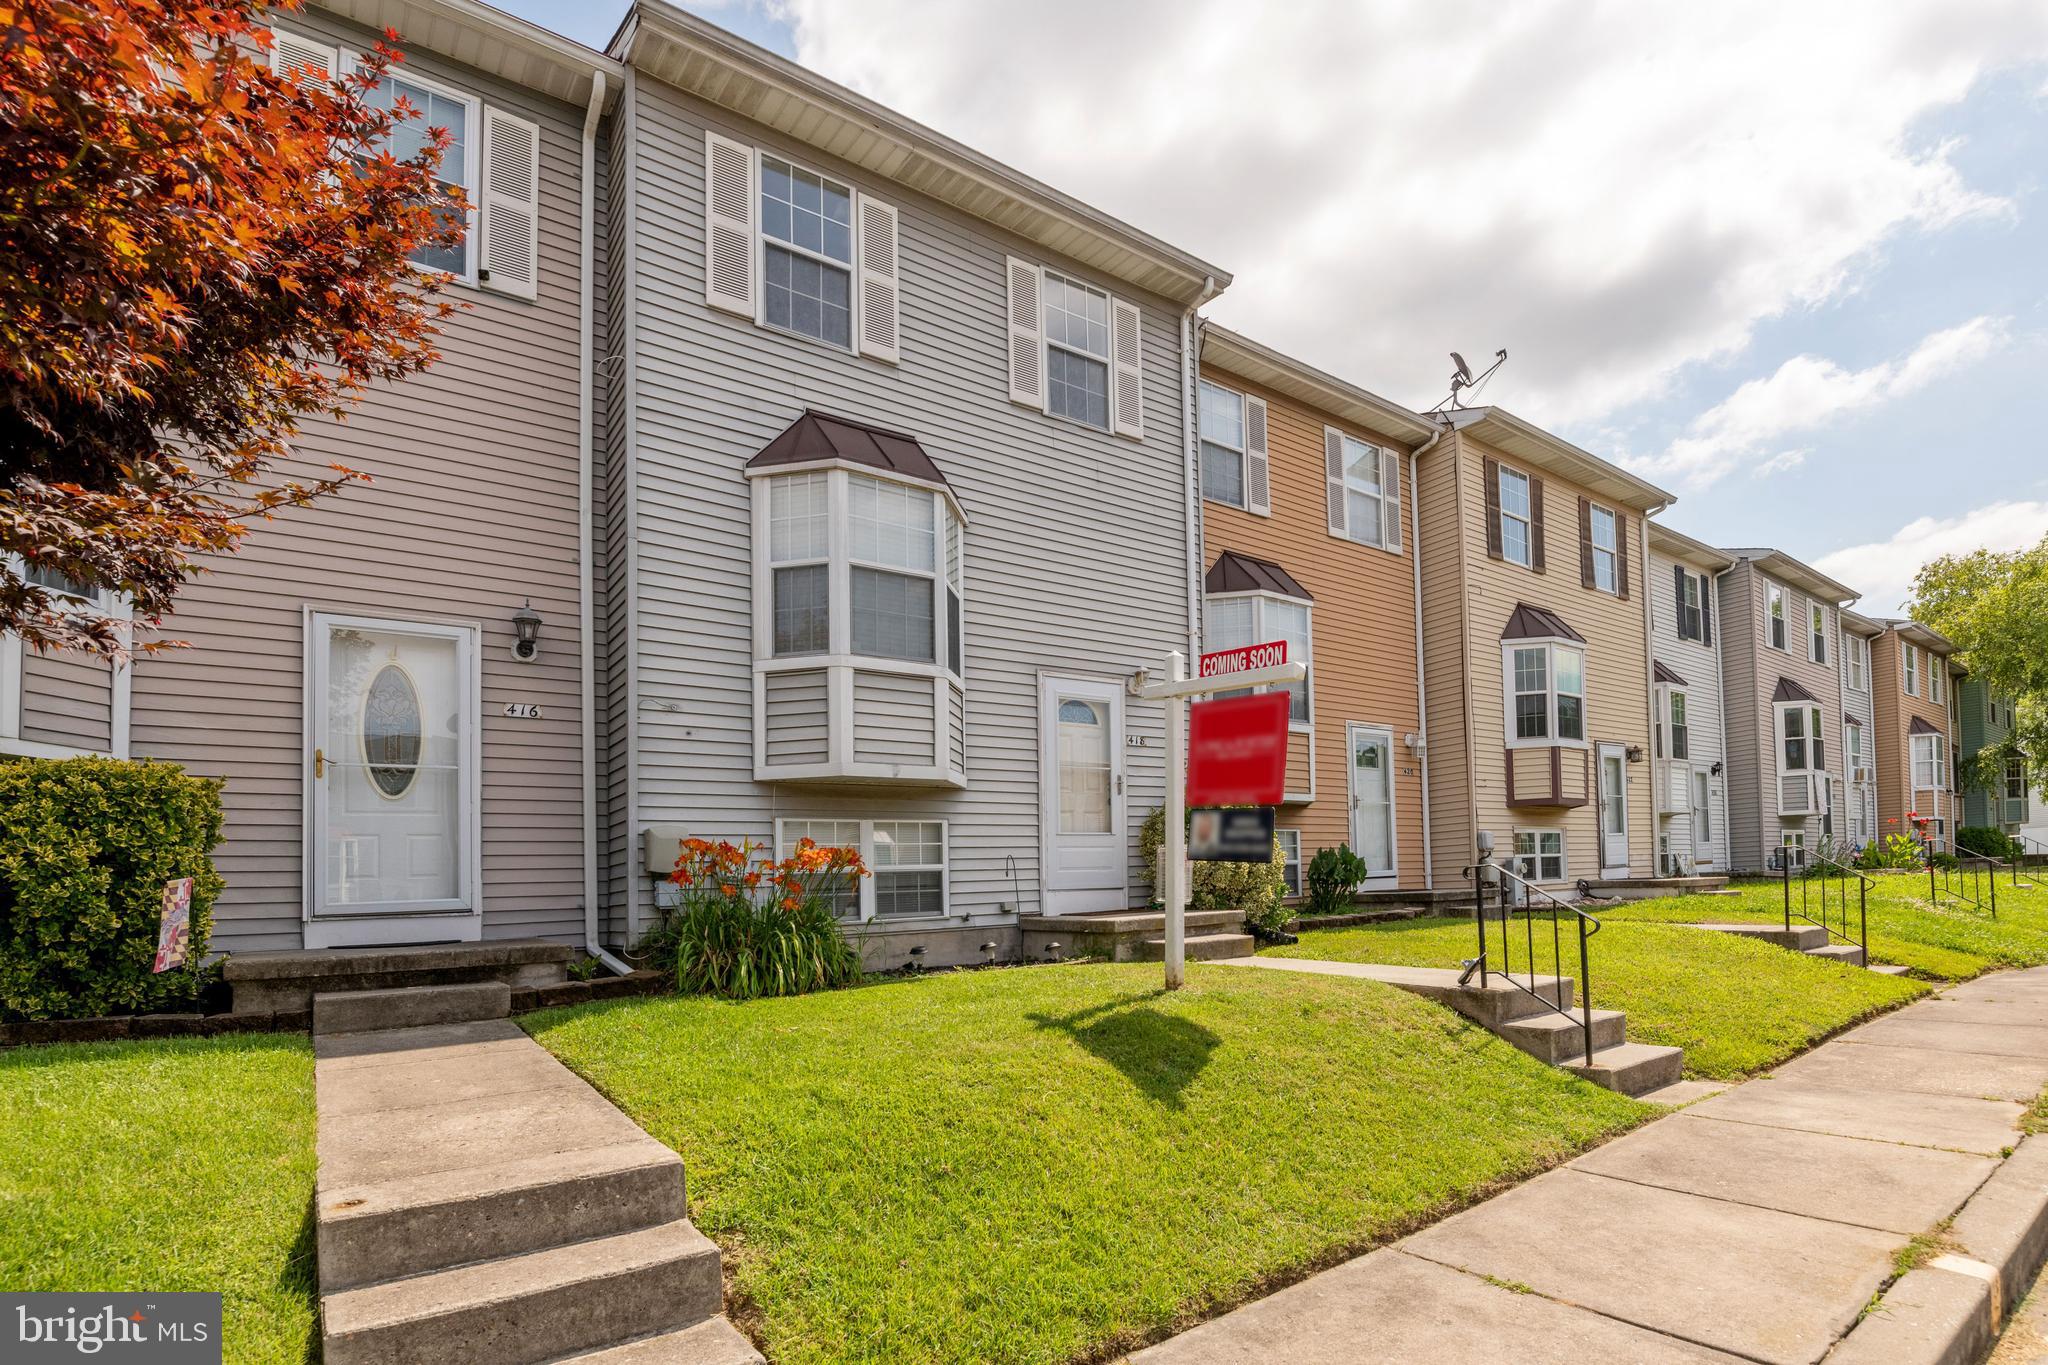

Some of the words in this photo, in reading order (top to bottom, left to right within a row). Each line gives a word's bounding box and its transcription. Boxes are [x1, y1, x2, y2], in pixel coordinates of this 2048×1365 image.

[1203, 652, 1247, 676] COMING
[1249, 645, 1283, 670] SOON
[506, 703, 538, 717] 416
[1128, 735, 1145, 745] 418
